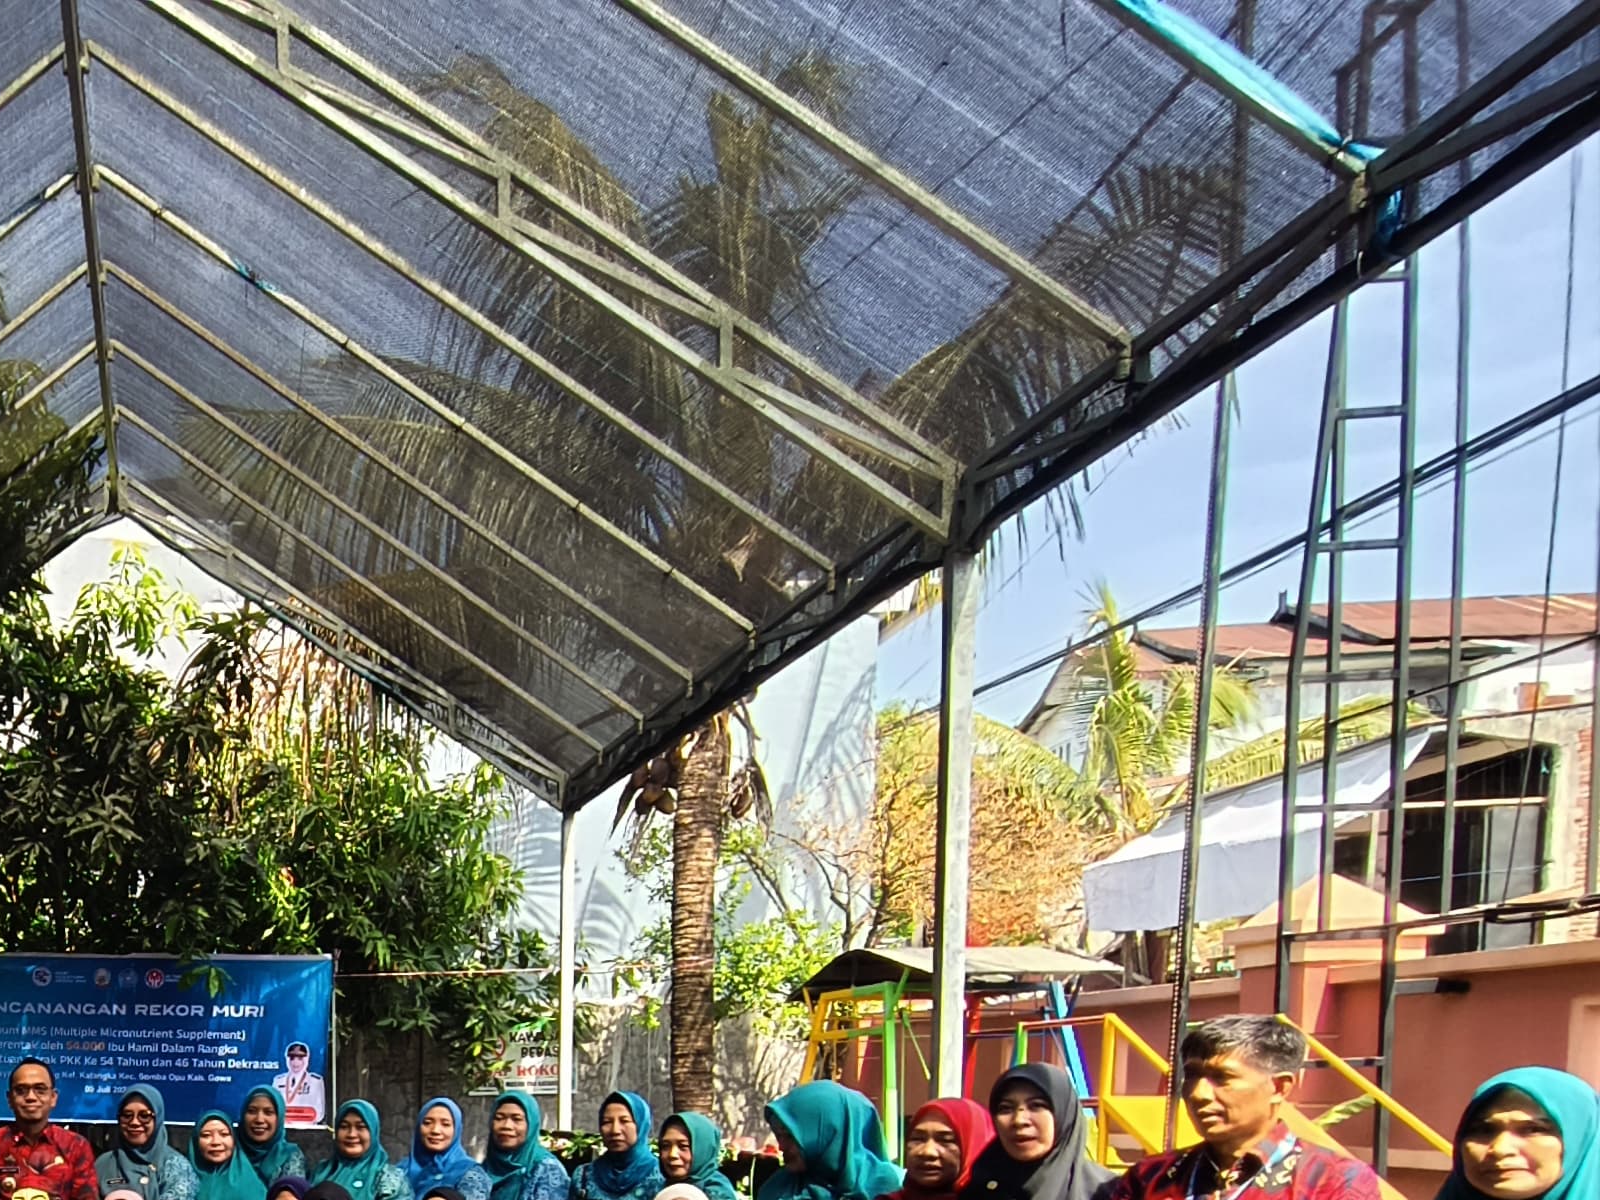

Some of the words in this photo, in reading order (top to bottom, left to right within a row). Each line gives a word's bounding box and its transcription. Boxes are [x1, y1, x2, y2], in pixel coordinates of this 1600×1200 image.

[134, 1003, 205, 1017] REKOR
[212, 1004, 265, 1018] MURI
[21, 1026, 47, 1036] MMS
[50, 1026, 97, 1039] (Multiple
[100, 1027, 173, 1039] Micronutrient
[175, 1029, 246, 1042] Supplement)
[41, 1040, 63, 1051] oleh
[108, 1042, 125, 1052] Ibu
[127, 1042, 158, 1053] Hamil
[161, 1043, 195, 1054] Dalam
[197, 1044, 238, 1057] Rangka
[59, 1055, 81, 1066] PKK
[84, 1056, 97, 1066] Ke
[99, 1056, 113, 1067] 54
[116, 1056, 150, 1067] Tahun
[151, 1057, 173, 1068] dan
[174, 1058, 189, 1068] 46
[191, 1058, 225, 1069] Tahun
[227, 1059, 279, 1070] Dekranas
